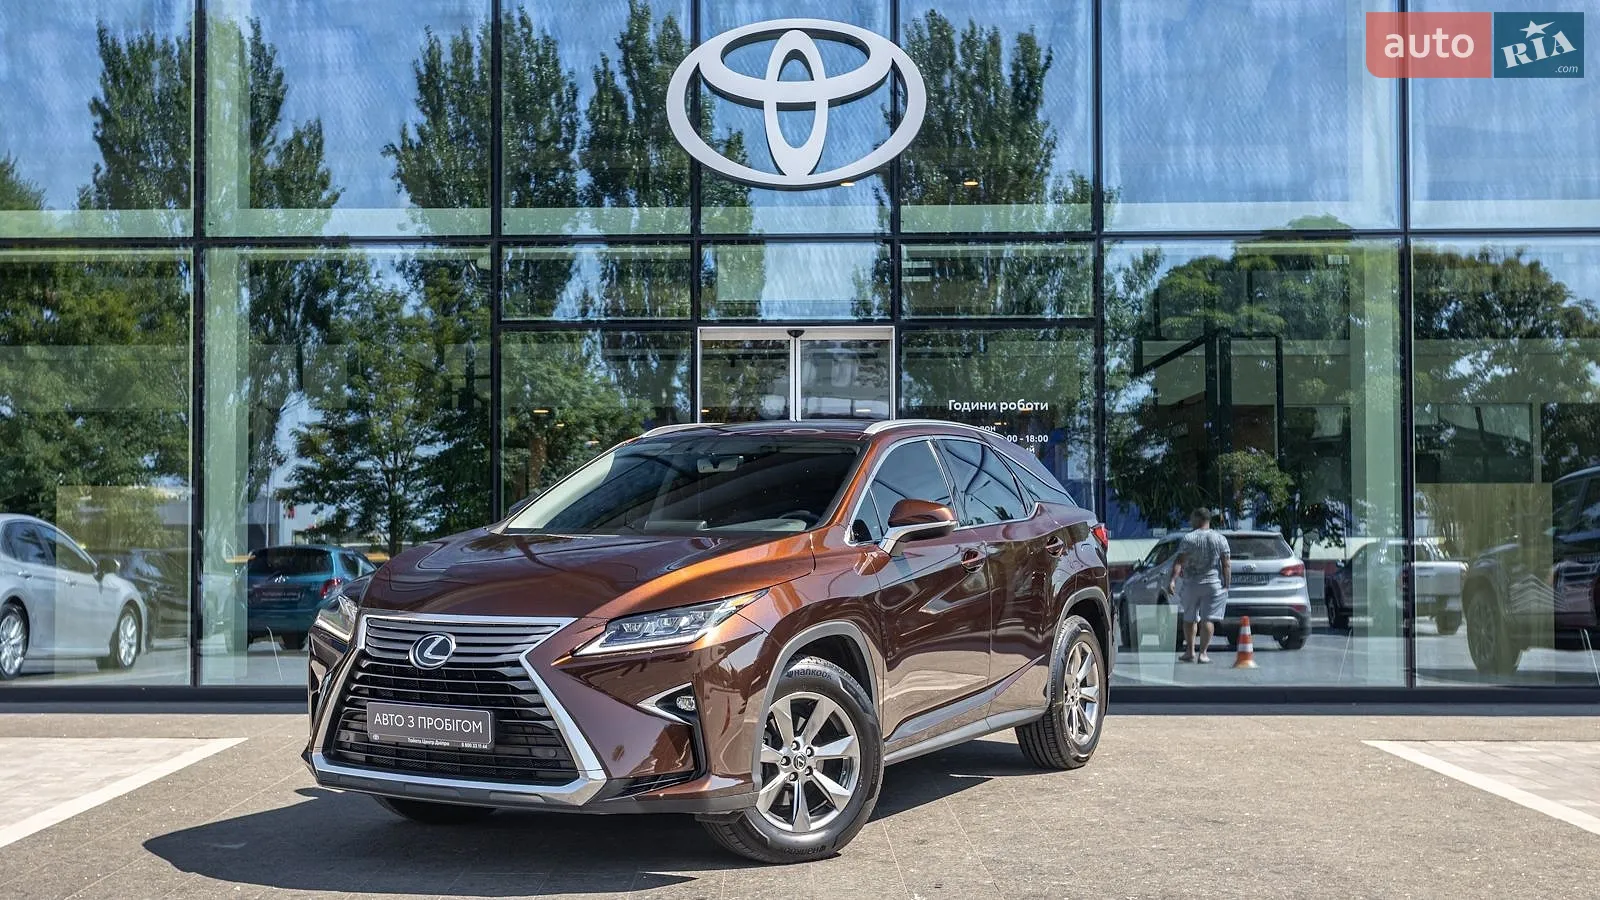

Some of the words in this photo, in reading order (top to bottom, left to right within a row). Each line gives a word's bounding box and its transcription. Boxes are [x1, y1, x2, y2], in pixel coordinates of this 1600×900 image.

[948, 399, 997, 412] Години
[1000, 399, 1049, 413] роботи
[1025, 434, 1049, 443] 18:00
[374, 712, 405, 727] АВТО
[418, 716, 483, 734] ПРОБІГОМ
